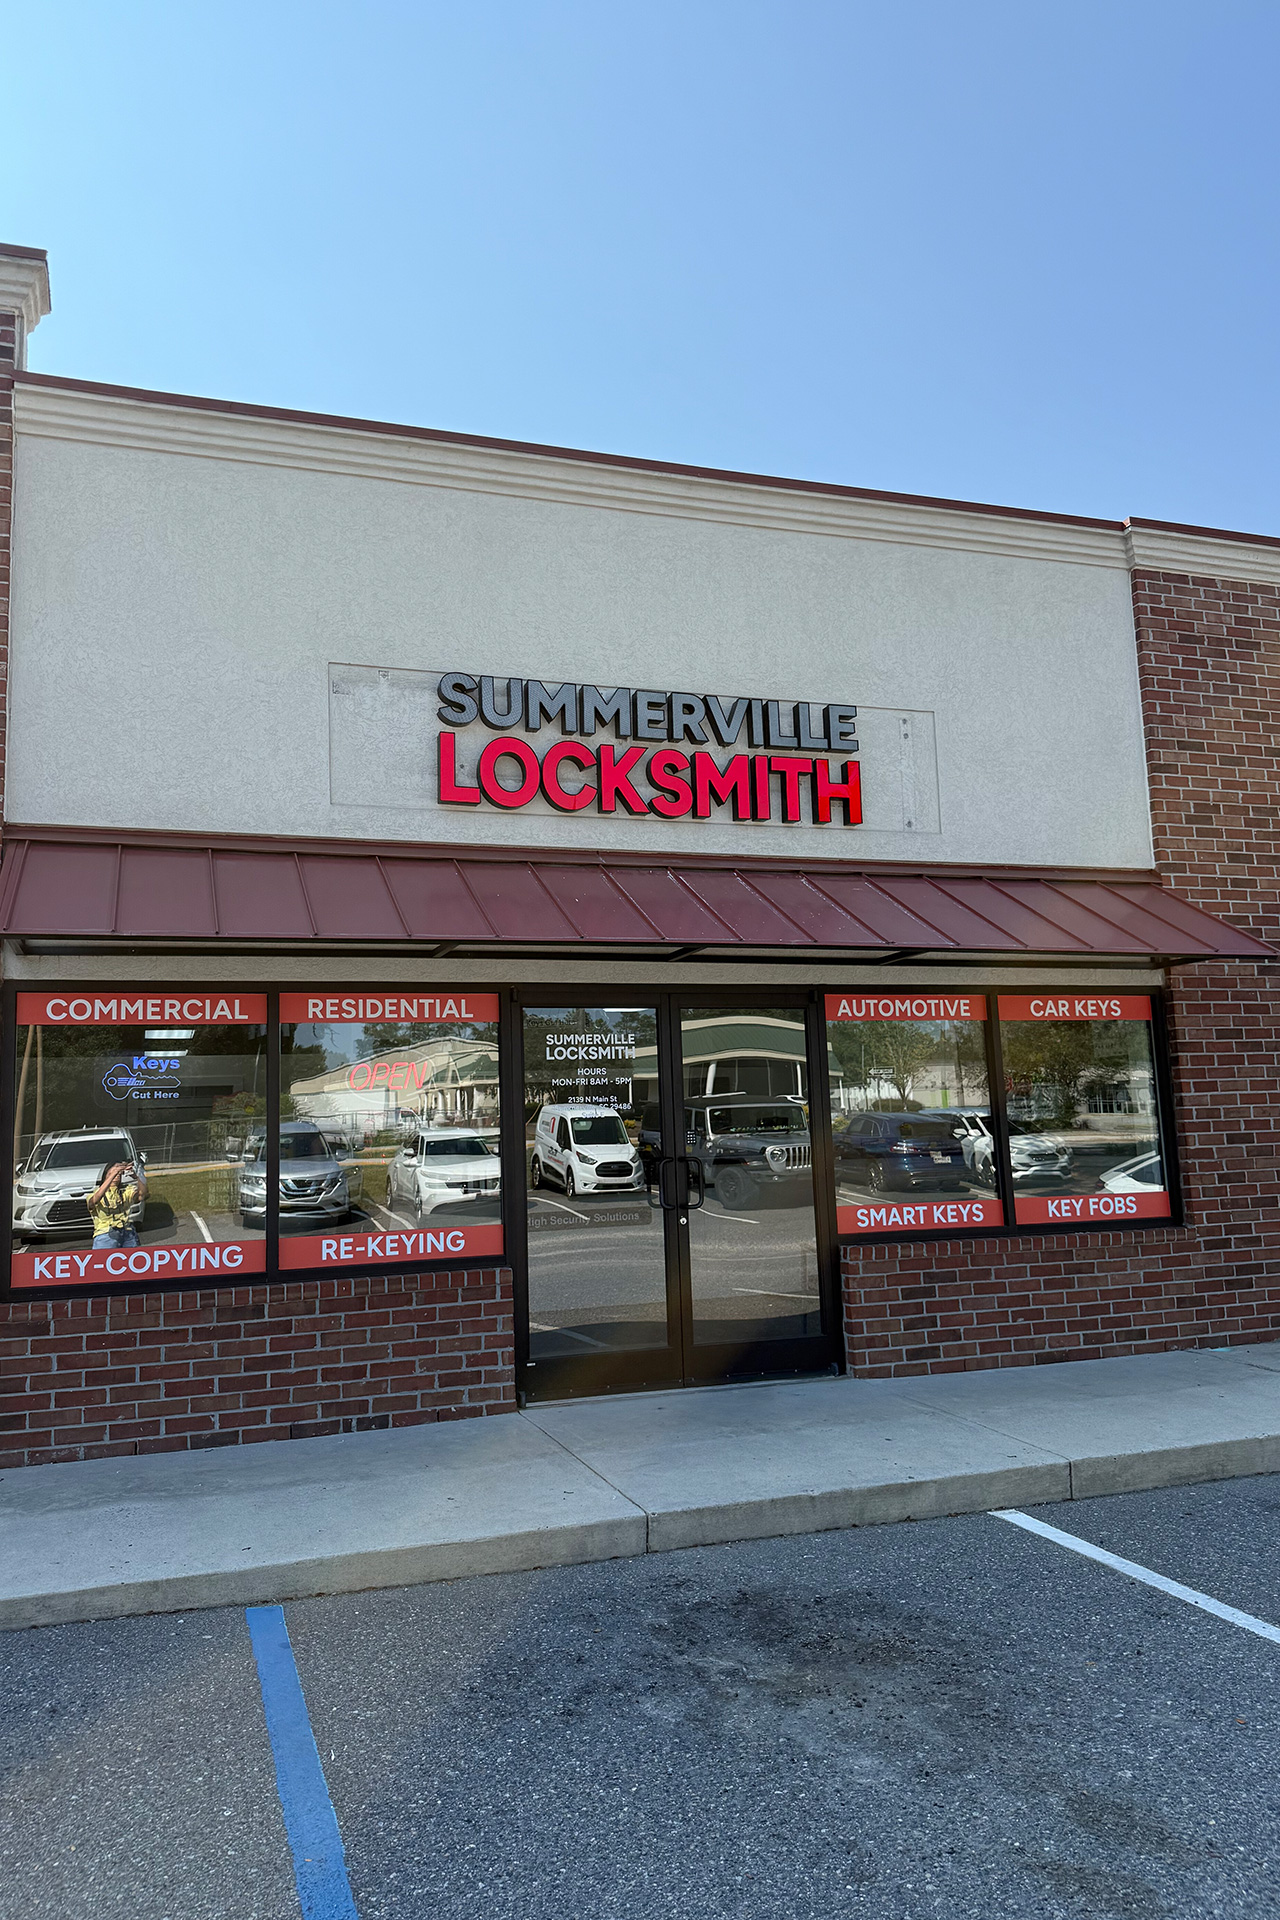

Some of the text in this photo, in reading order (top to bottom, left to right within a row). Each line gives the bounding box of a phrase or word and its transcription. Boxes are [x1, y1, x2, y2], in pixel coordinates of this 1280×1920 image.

[437, 672, 860, 753] SUMMERVILLE
[437, 731, 864, 826] LOCKSMITH
[46, 998, 249, 1021] COMMERCIAL
[307, 998, 474, 1019] RESIDENTIAL
[837, 998, 971, 1018] AUTOMOTIVE
[1030, 999, 1122, 1018] CAR KEYS
[546, 1034, 635, 1045] SUMMERVILLE
[546, 1046, 636, 1061] LOCKSMITH
[132, 1056, 181, 1073] Keys
[577, 1067, 607, 1076] HOURS
[349, 1061, 428, 1091] OPEN
[551, 1078, 588, 1086] MON-FRI
[589, 1077, 608, 1086] 8AM
[615, 1077, 632, 1085] 5PM
[132, 1091, 180, 1099] Cut Here
[856, 1203, 984, 1229] SMART KEYS
[1047, 1196, 1137, 1219] KEY FOBS
[550, 1215, 590, 1226] Security
[593, 1212, 640, 1223] Solutions
[321, 1230, 466, 1262] RE-KEYING
[33, 1245, 244, 1281] KEY-COPYING
